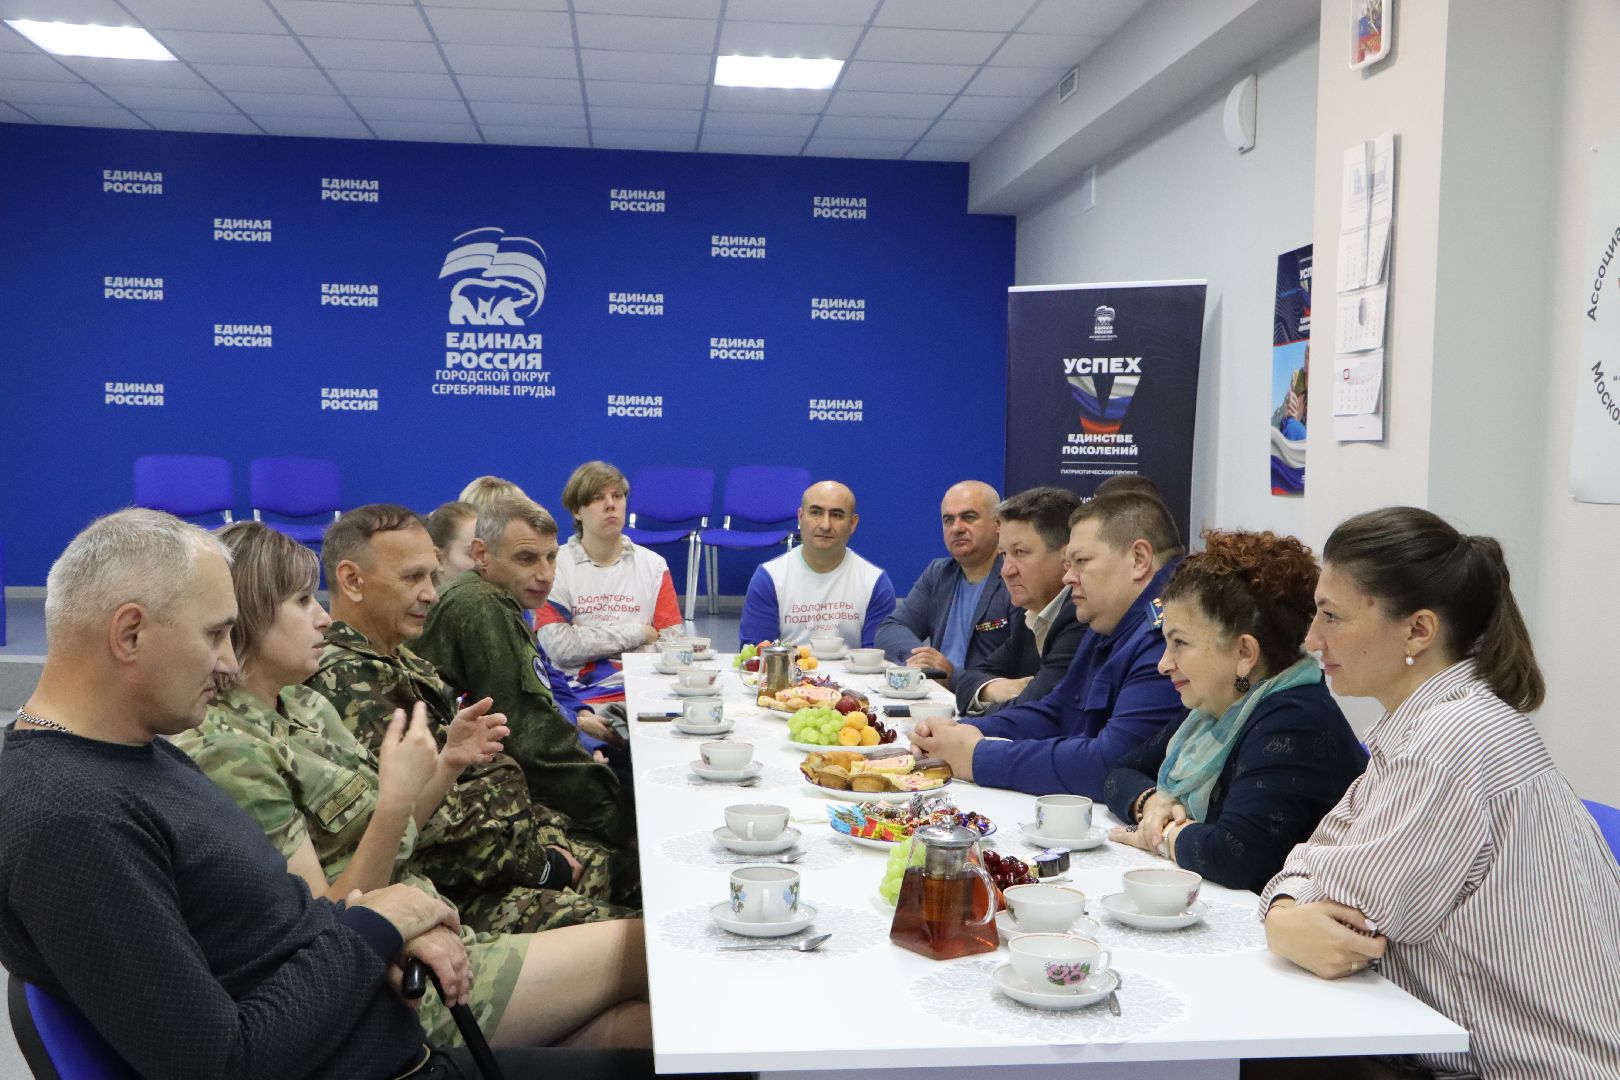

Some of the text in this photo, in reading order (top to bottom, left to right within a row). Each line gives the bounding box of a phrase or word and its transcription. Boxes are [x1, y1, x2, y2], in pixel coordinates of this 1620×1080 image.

[103, 169, 163, 181] ЕДИНАЯ
[103, 181, 163, 195] РОССИЯ
[321, 178, 379, 190] ЕДИНАЯ
[321, 189, 379, 203] РОССИЯ
[610, 189, 665, 201] ЕДИНАЯ
[610, 200, 665, 213] РОССИЯ
[813, 196, 867, 208] ЕДИНАЯ
[813, 207, 867, 220] РОССИЯ
[213, 218, 272, 230] ЕДИНАЯ
[213, 229, 272, 242] РОССИЯ
[711, 235, 766, 247] ЕДИНАЯ
[711, 246, 766, 259] РОССИЯ
[104, 276, 164, 288] ЕДИНАЯ
[104, 288, 164, 301] РОССИЯ
[321, 283, 379, 295] ЕДИНАЯ
[321, 295, 379, 308] РОССИЯ
[608, 292, 664, 304] ЕДИНАЯ
[810, 297, 866, 309] ЕДИНАЯ
[608, 303, 664, 316] РОССИЯ
[810, 309, 866, 321] РОССИЯ
[213, 324, 273, 336] ЕДИНАЯ
[213, 335, 273, 348] РОССИЯ
[446, 332, 543, 350] ЕДИНАЯ
[709, 337, 765, 349] ЕДИНАЯ
[446, 351, 543, 370] РОССИЯ
[709, 348, 765, 361] РОССИЯ
[1063, 357, 1142, 374] УСПЕХ
[435, 369, 551, 383] ГОРОДСКОЙ ОКРУГ
[104, 382, 165, 394] ЕДИНАЯ
[320, 387, 379, 399] ЕДИНАЯ
[431, 383, 556, 398] СЕРЕБРЯНЫЕ ПРУДЫ
[1591, 360, 1620, 425] Моско
[104, 393, 165, 406] РОССИЯ
[320, 399, 379, 411] РОССИЯ
[607, 394, 663, 406] ЕДИНАЯ
[808, 398, 863, 410] ЕДИНАЯ
[607, 406, 663, 418] РОССИЯ
[808, 410, 863, 422] РОССИЯ
[1067, 433, 1133, 444] ЕДИНСТВЕ
[1062, 444, 1139, 456] ПОКОЛЕНИЙ
[792, 601, 854, 613] ВОЛОНТЕРЫ
[784, 611, 860, 624] ПОДМОСКОВЬЯ
